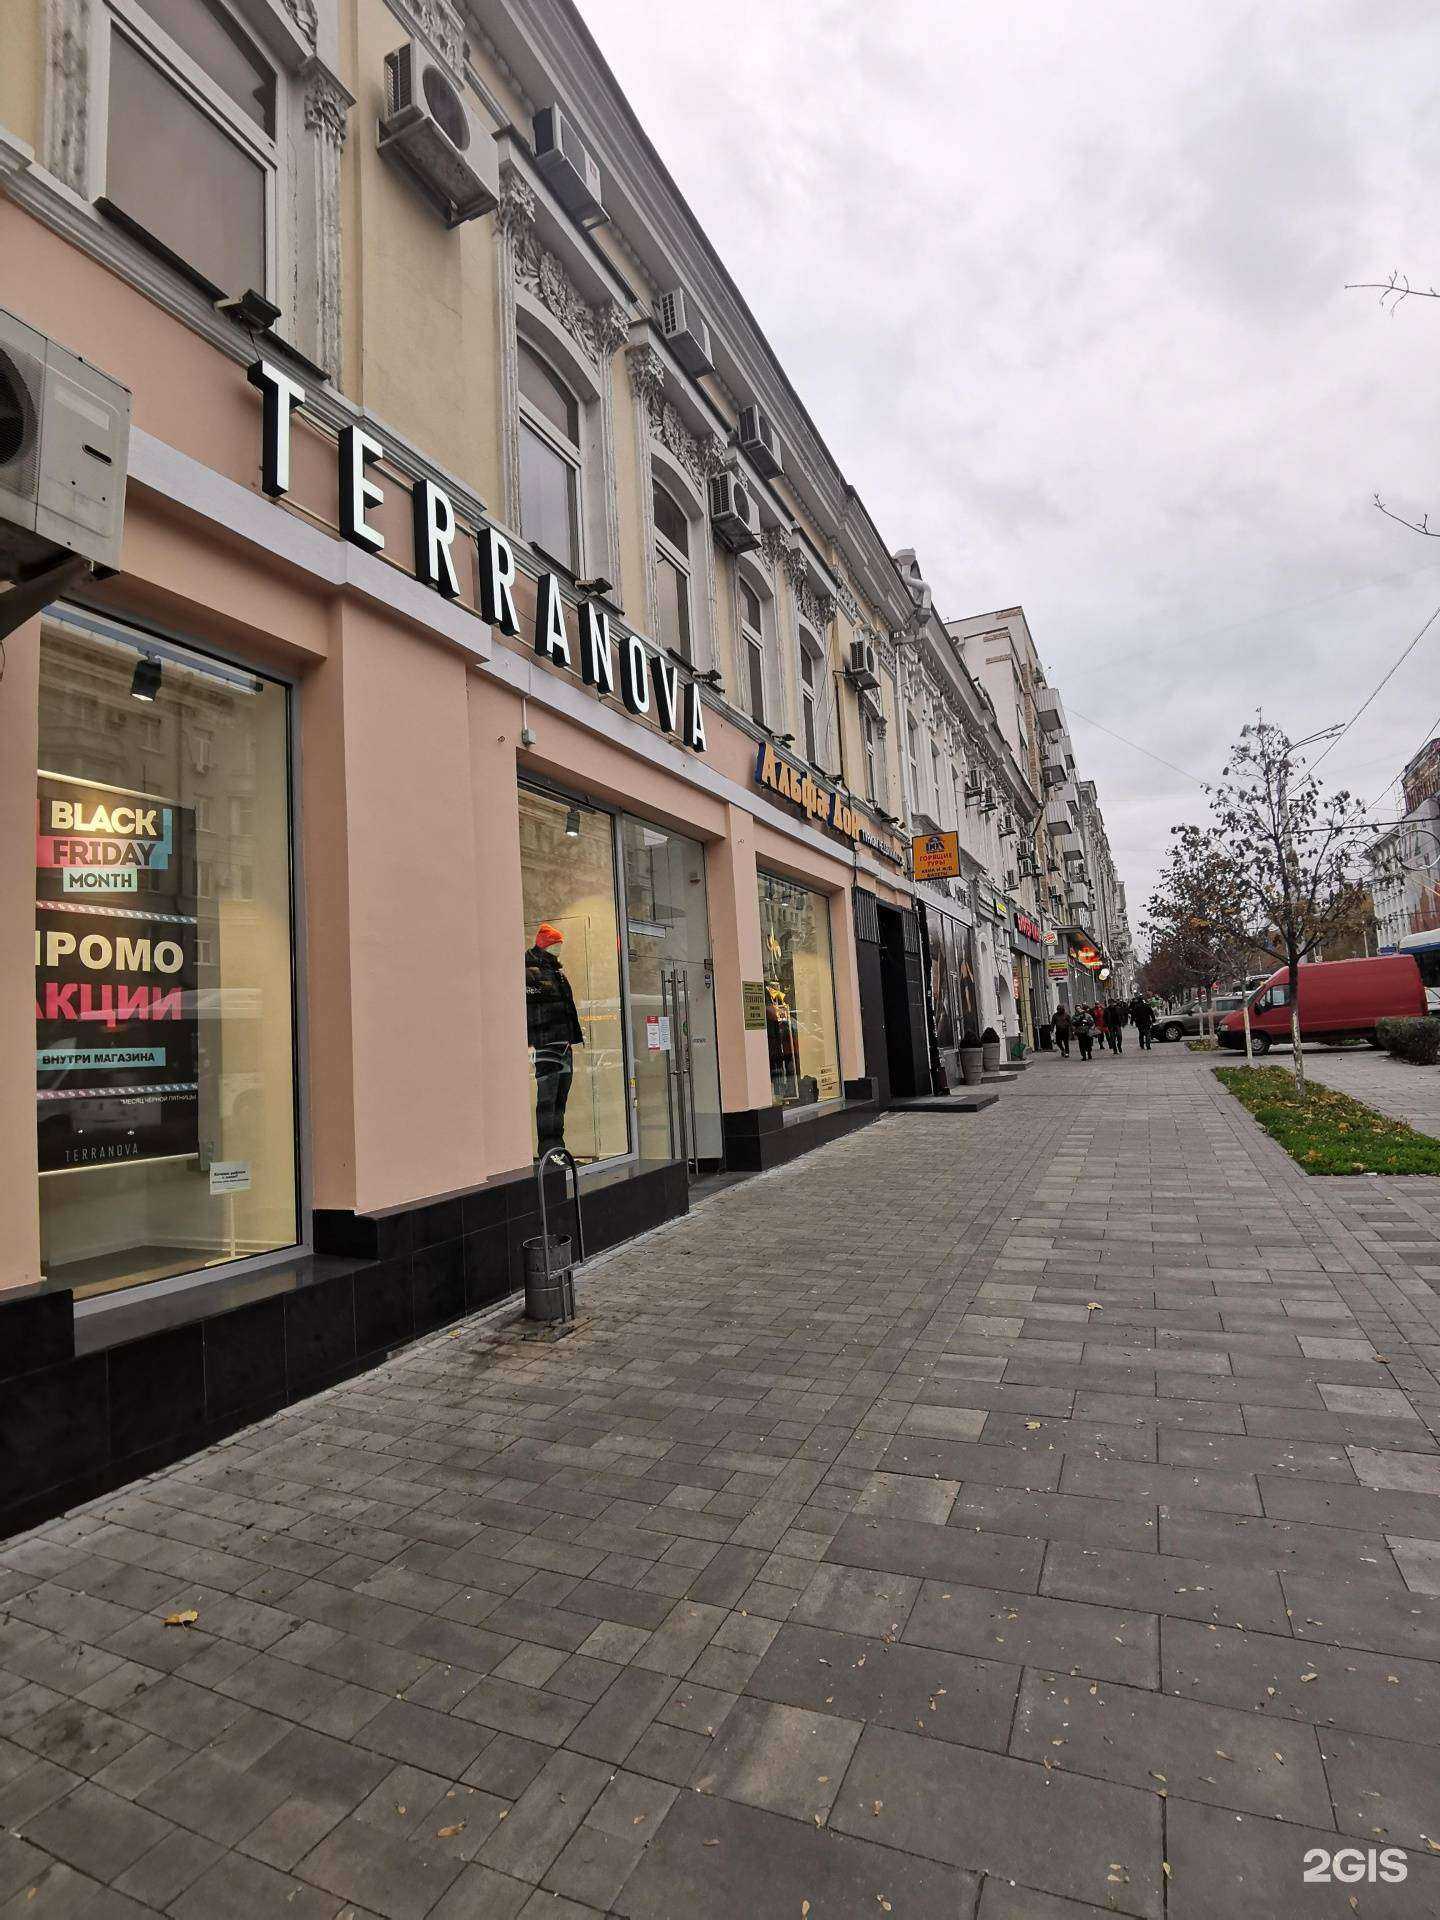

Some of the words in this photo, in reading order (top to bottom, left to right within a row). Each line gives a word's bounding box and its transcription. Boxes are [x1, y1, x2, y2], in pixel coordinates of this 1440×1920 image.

[250, 360, 707, 752] TERRANOVA
[756, 742, 830, 818] Альфа
[51, 800, 157, 836] BLACK
[53, 839, 156, 866] FRIDAY
[68, 872, 133, 889] MONTH
[35, 930, 184, 974] РОМО
[36, 982, 183, 1028] КЦИИ
[42, 1054, 91, 1066] ВНУТРИ
[94, 1052, 156, 1064] МАГАЗИНА
[65, 1143, 139, 1162] TERRANOVA
